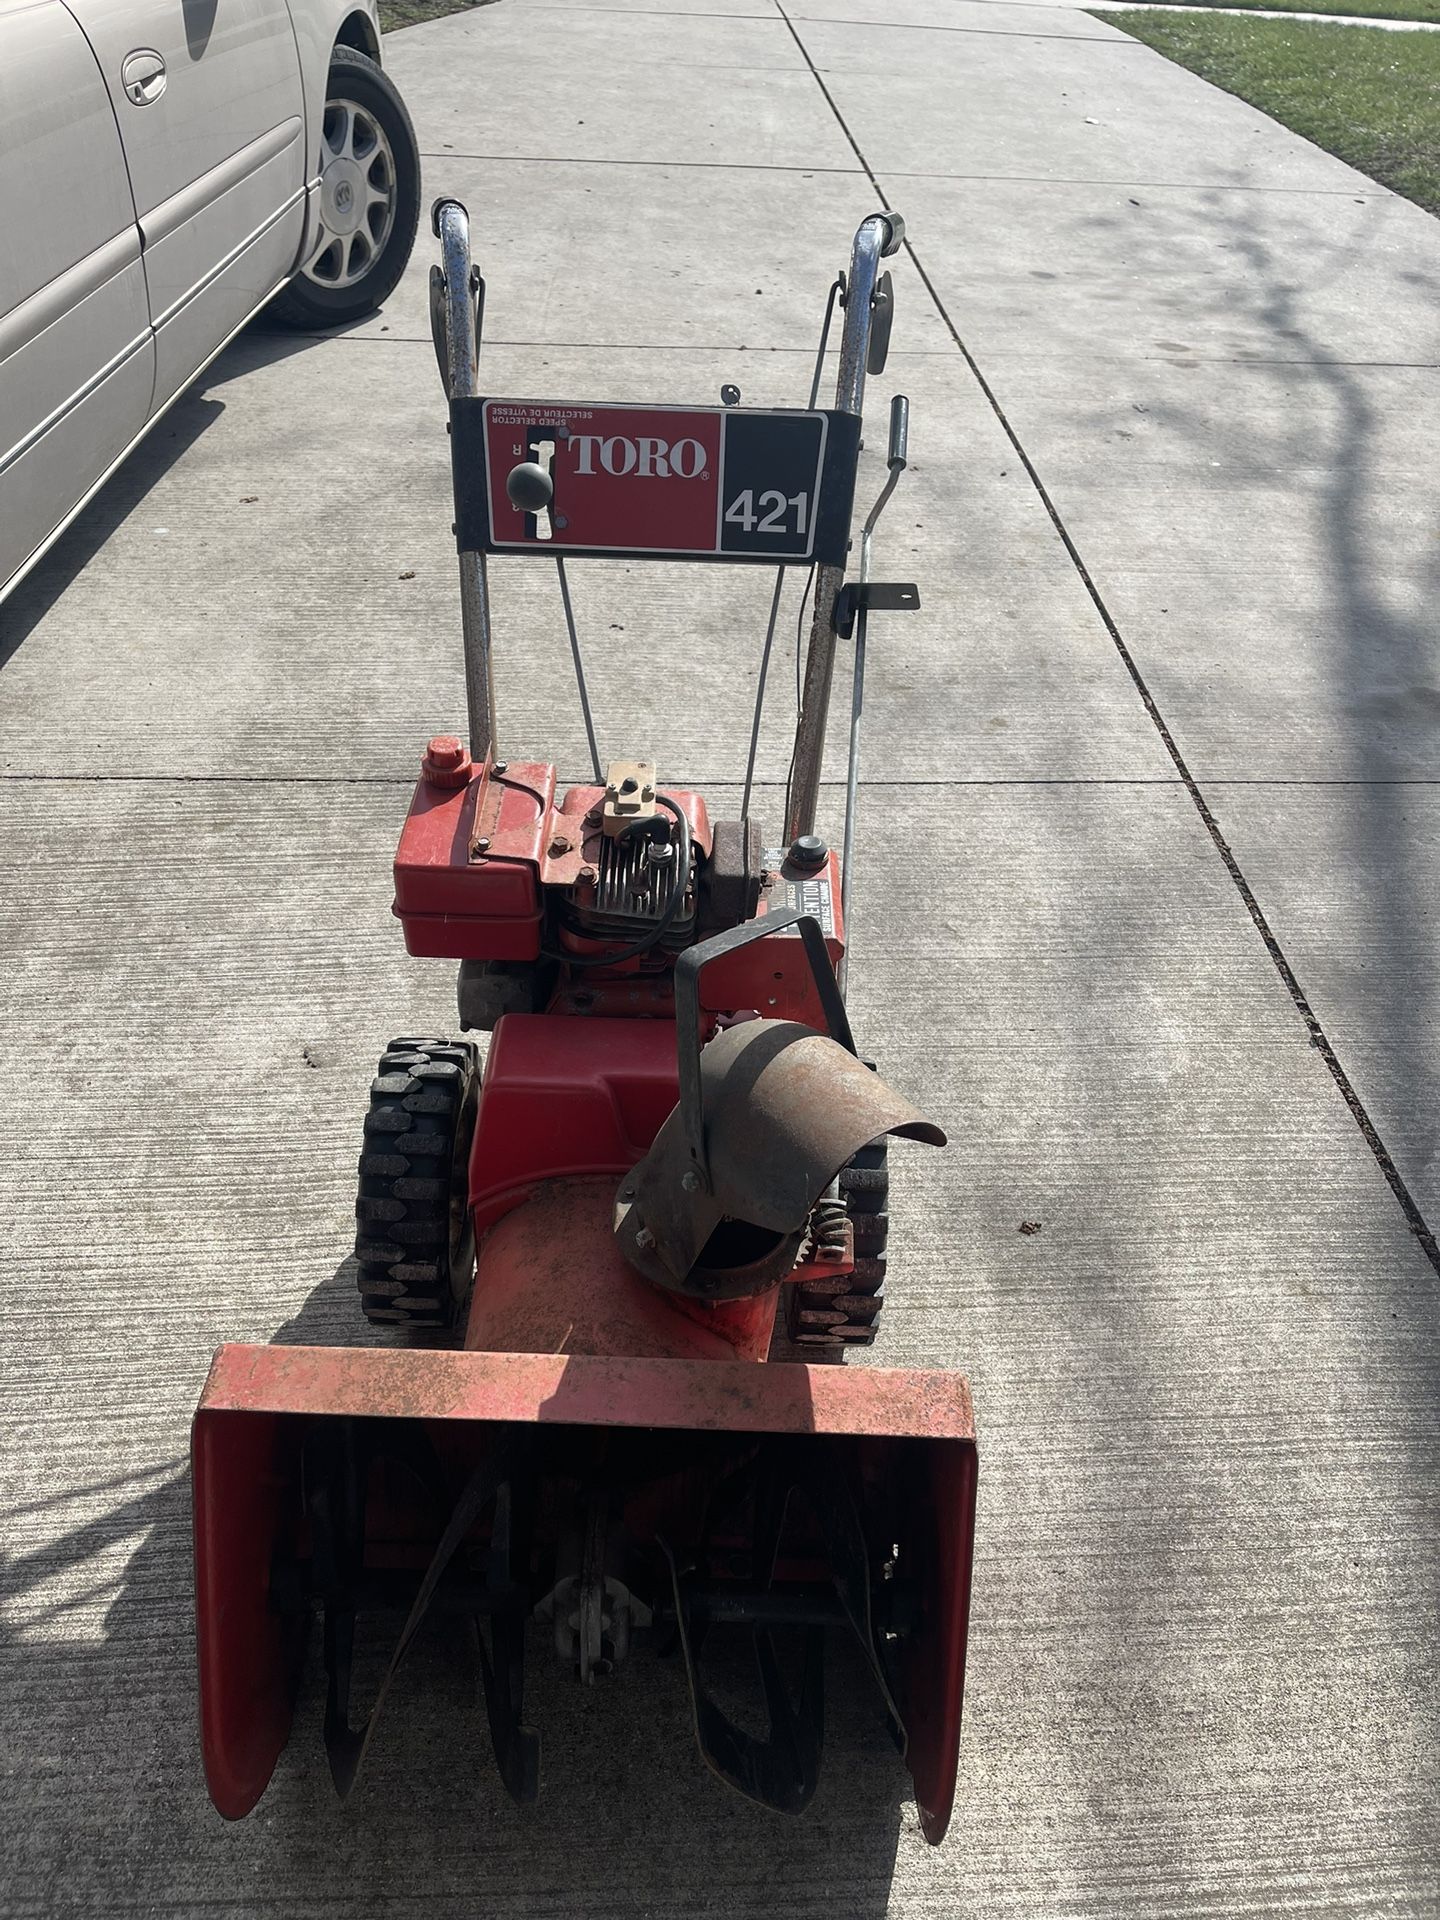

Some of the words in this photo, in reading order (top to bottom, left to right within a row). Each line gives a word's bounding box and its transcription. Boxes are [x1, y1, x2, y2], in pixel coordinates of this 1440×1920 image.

[492, 407, 527, 416] VITESSE
[529, 407, 541, 417] DE
[544, 409, 593, 419] SELECTEUR
[492, 416, 536, 425] SELECTOR
[539, 418, 567, 426] SPEED
[512, 444, 521, 456] R
[725, 489, 808, 534] 421
[821, 905, 832, 932] SURFACE
